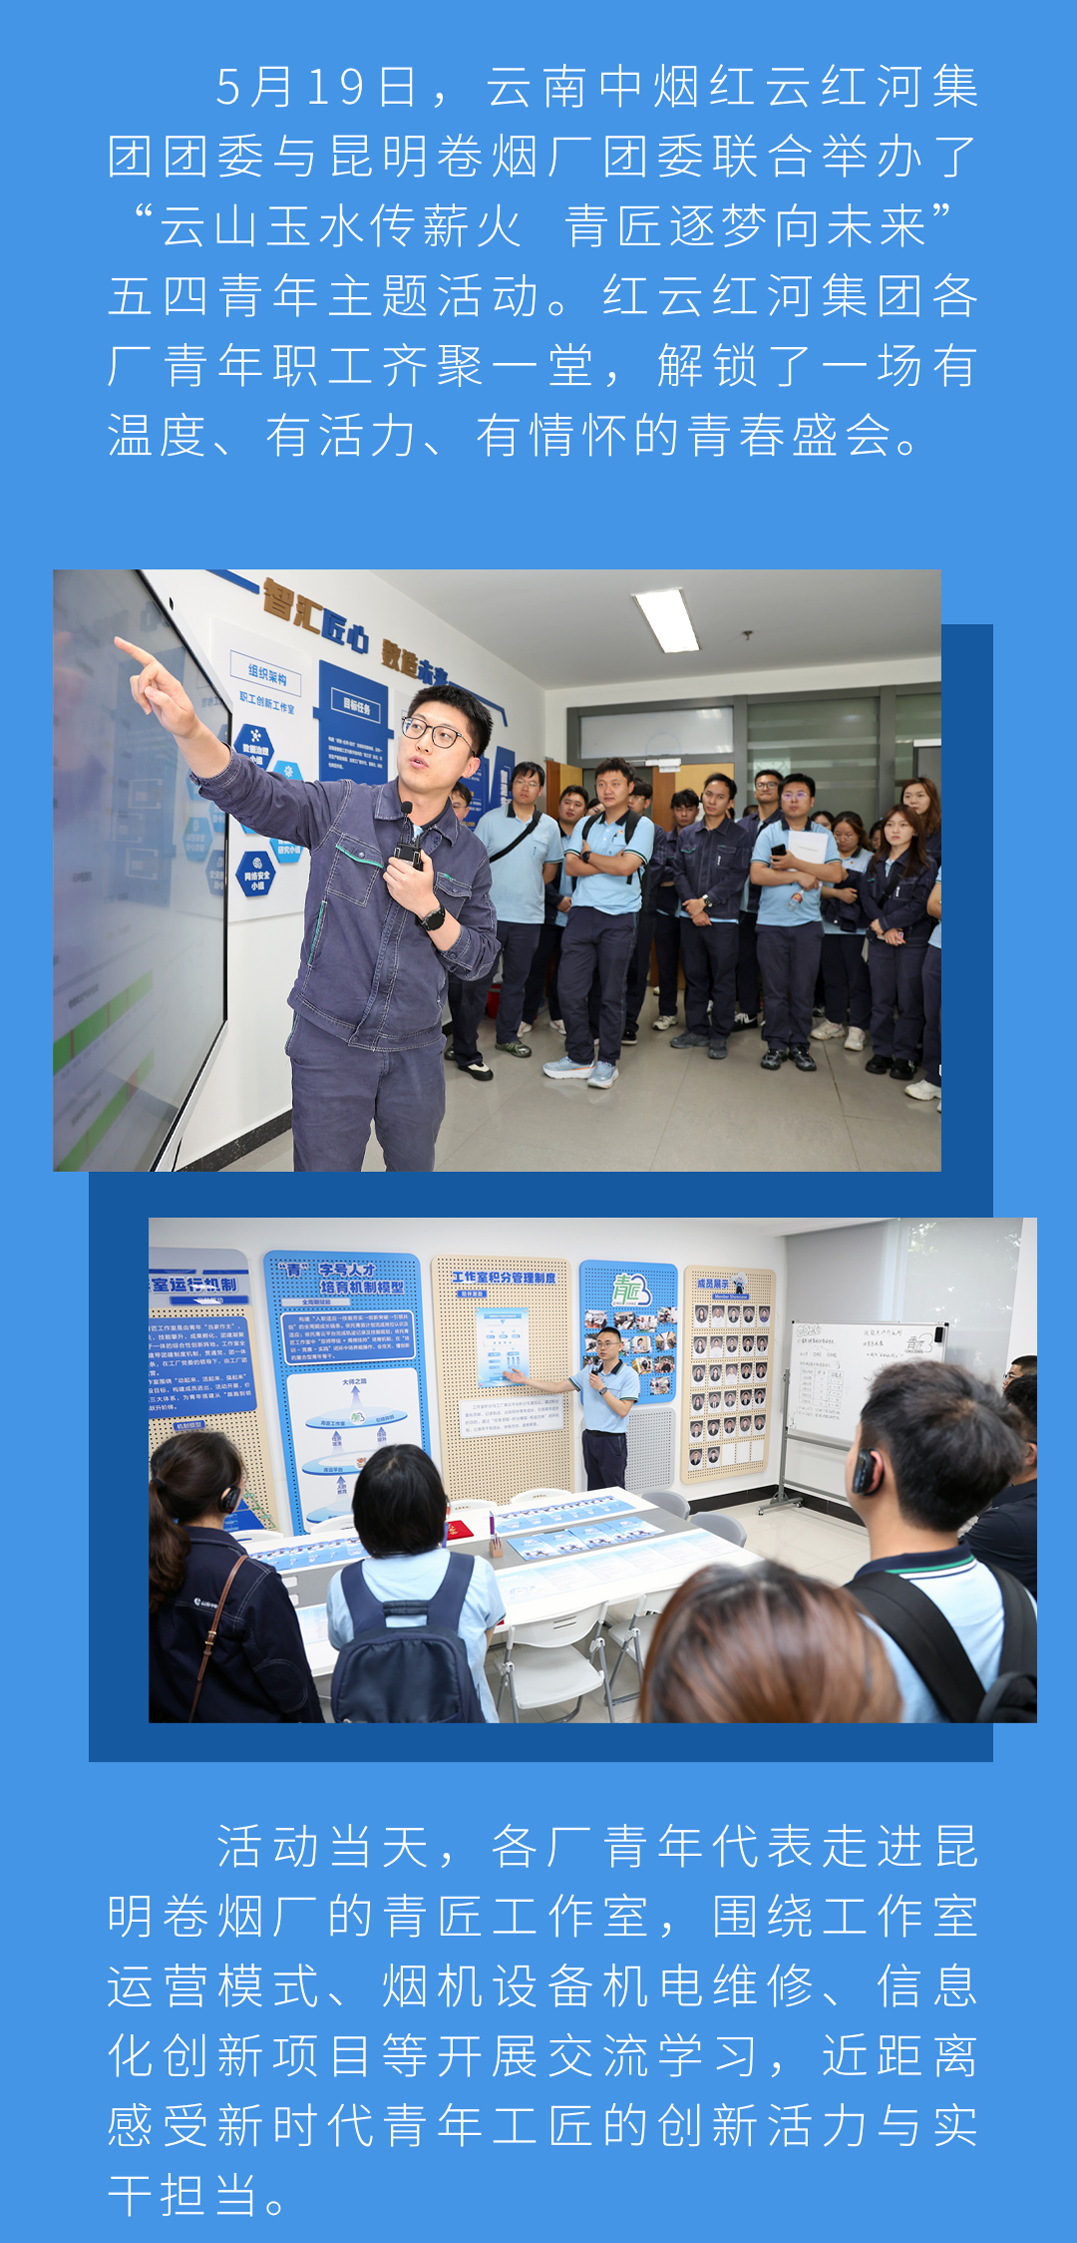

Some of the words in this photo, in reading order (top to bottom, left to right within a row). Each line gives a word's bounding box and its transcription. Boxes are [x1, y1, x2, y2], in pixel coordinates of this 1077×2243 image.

[263, 577, 369, 654] 智汇匠心
[248, 663, 287, 686] 组织架构
[239, 690, 295, 715] 职工创新工作室
[343, 697, 371, 716] 目标任务
[244, 871, 270, 881] 网络安全
[251, 882, 265, 890] 小组
[319, 1263, 376, 1277] 字号人才
[149, 1277, 237, 1292] 室运行机制
[452, 1271, 556, 1284] 工作室积分管理制度
[697, 1279, 729, 1289] 成员展示
[320, 1281, 404, 1294] 培育机制模型
